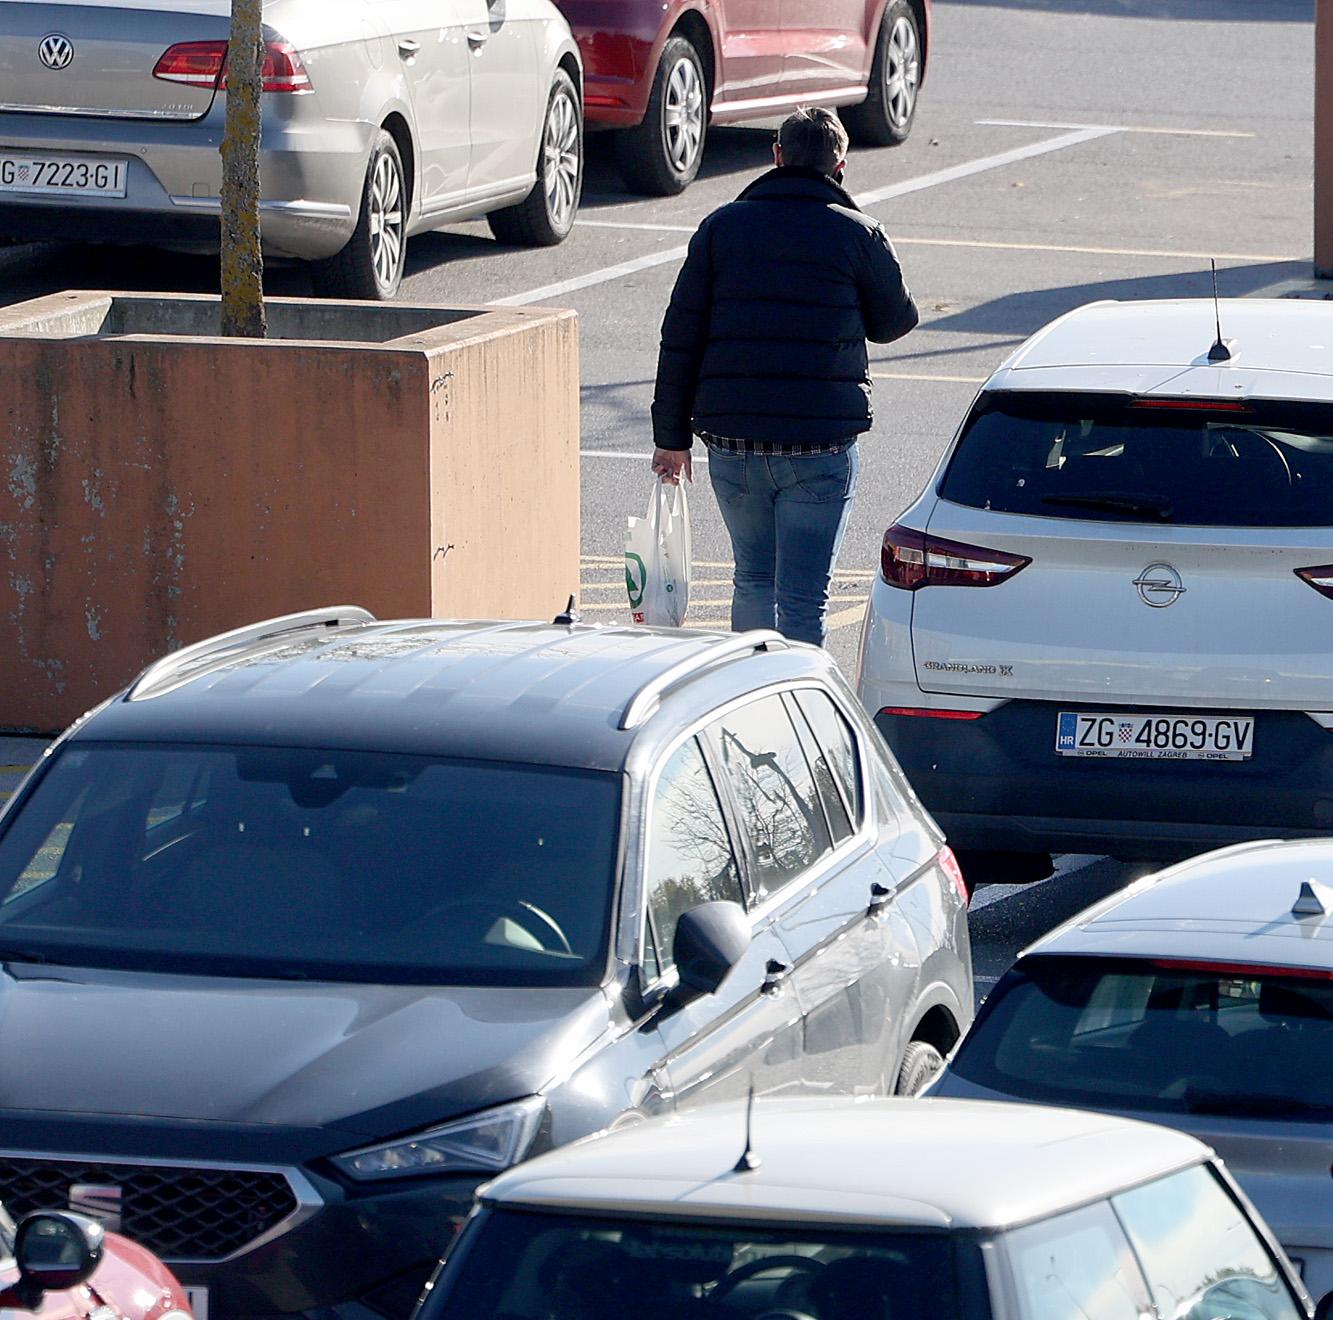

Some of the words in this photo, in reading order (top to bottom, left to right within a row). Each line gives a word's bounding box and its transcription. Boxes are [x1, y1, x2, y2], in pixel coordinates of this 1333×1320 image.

[0, 160, 15, 184] G
[924, 661, 997, 674] GRANDLAND
[999, 665, 1013, 676] X
[1060, 735, 1074, 745] HR
[1079, 717, 1115, 747] ZG
[1117, 750, 1154, 758] AUTOWILL
[1157, 751, 1188, 759] ZAGREB
